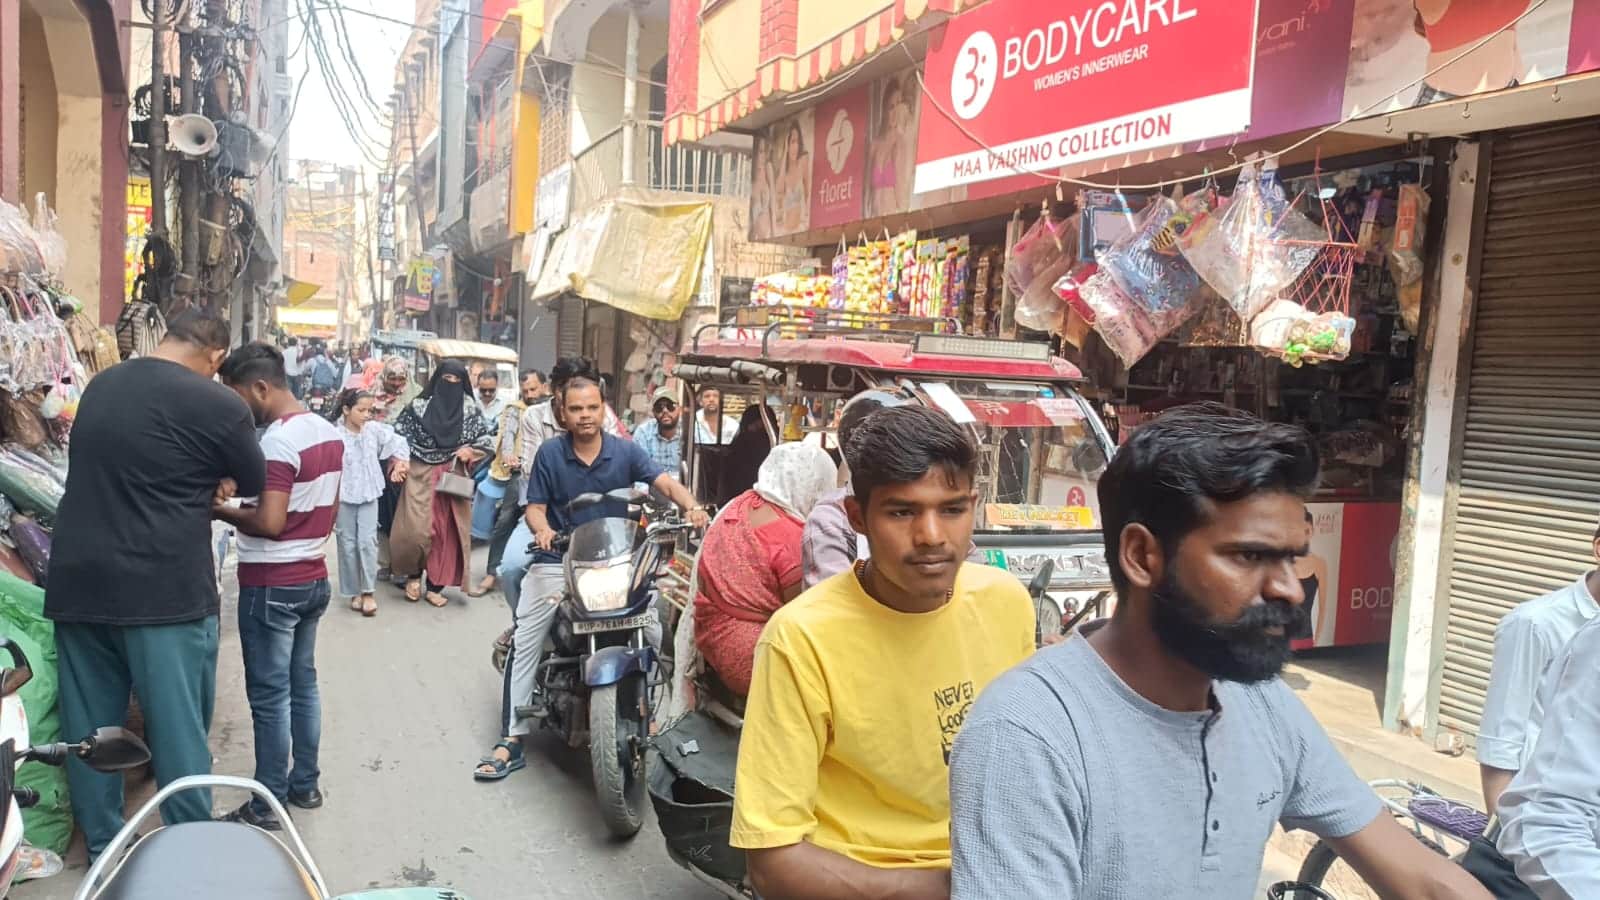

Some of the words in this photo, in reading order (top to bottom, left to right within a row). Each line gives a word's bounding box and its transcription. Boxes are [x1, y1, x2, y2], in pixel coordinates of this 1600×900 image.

[1033, 66, 1081, 91] WOMEN'S
[1081, 44, 1149, 78] INNERWEAR
[953, 157, 982, 178] MAA
[987, 142, 1052, 171] VAISHNO
[1058, 113, 1172, 154] COLLECTION
[818, 176, 853, 206] floret
